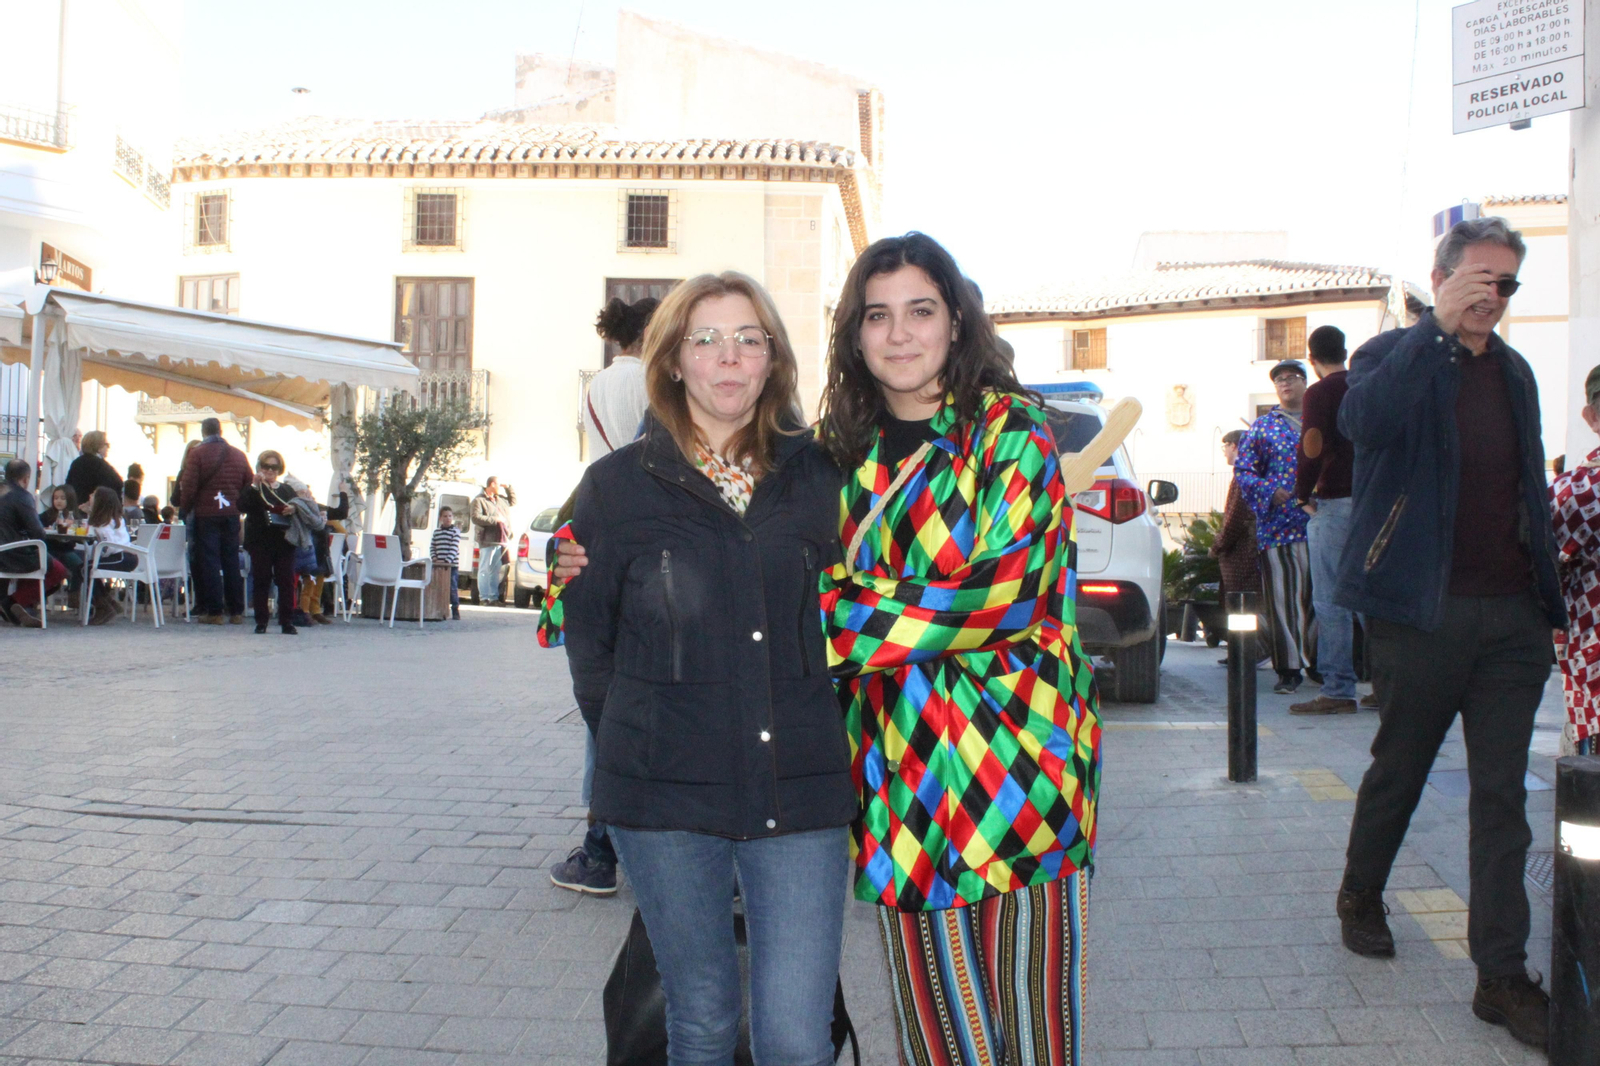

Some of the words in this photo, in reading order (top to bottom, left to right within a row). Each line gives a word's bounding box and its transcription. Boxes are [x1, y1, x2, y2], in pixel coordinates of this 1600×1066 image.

[1465, 14, 1499, 28] CARGA
[1500, 4, 1569, 30] LABORABLES
[1474, 40, 1486, 49] DE
[1518, 30, 1524, 38] h
[1526, 27, 1532, 35] a
[1474, 51, 1487, 60] DE
[1490, 44, 1515, 56] 16:00
[1518, 42, 1524, 50] h
[1526, 40, 1532, 48] a
[1535, 32, 1561, 45] 18:00
[1502, 56, 1516, 66] 20
[1520, 44, 1568, 62] minutos
[1470, 72, 1564, 104] RESERVADO
[1467, 101, 1518, 120] POLICIA
[1523, 90, 1568, 108] LOCAL
